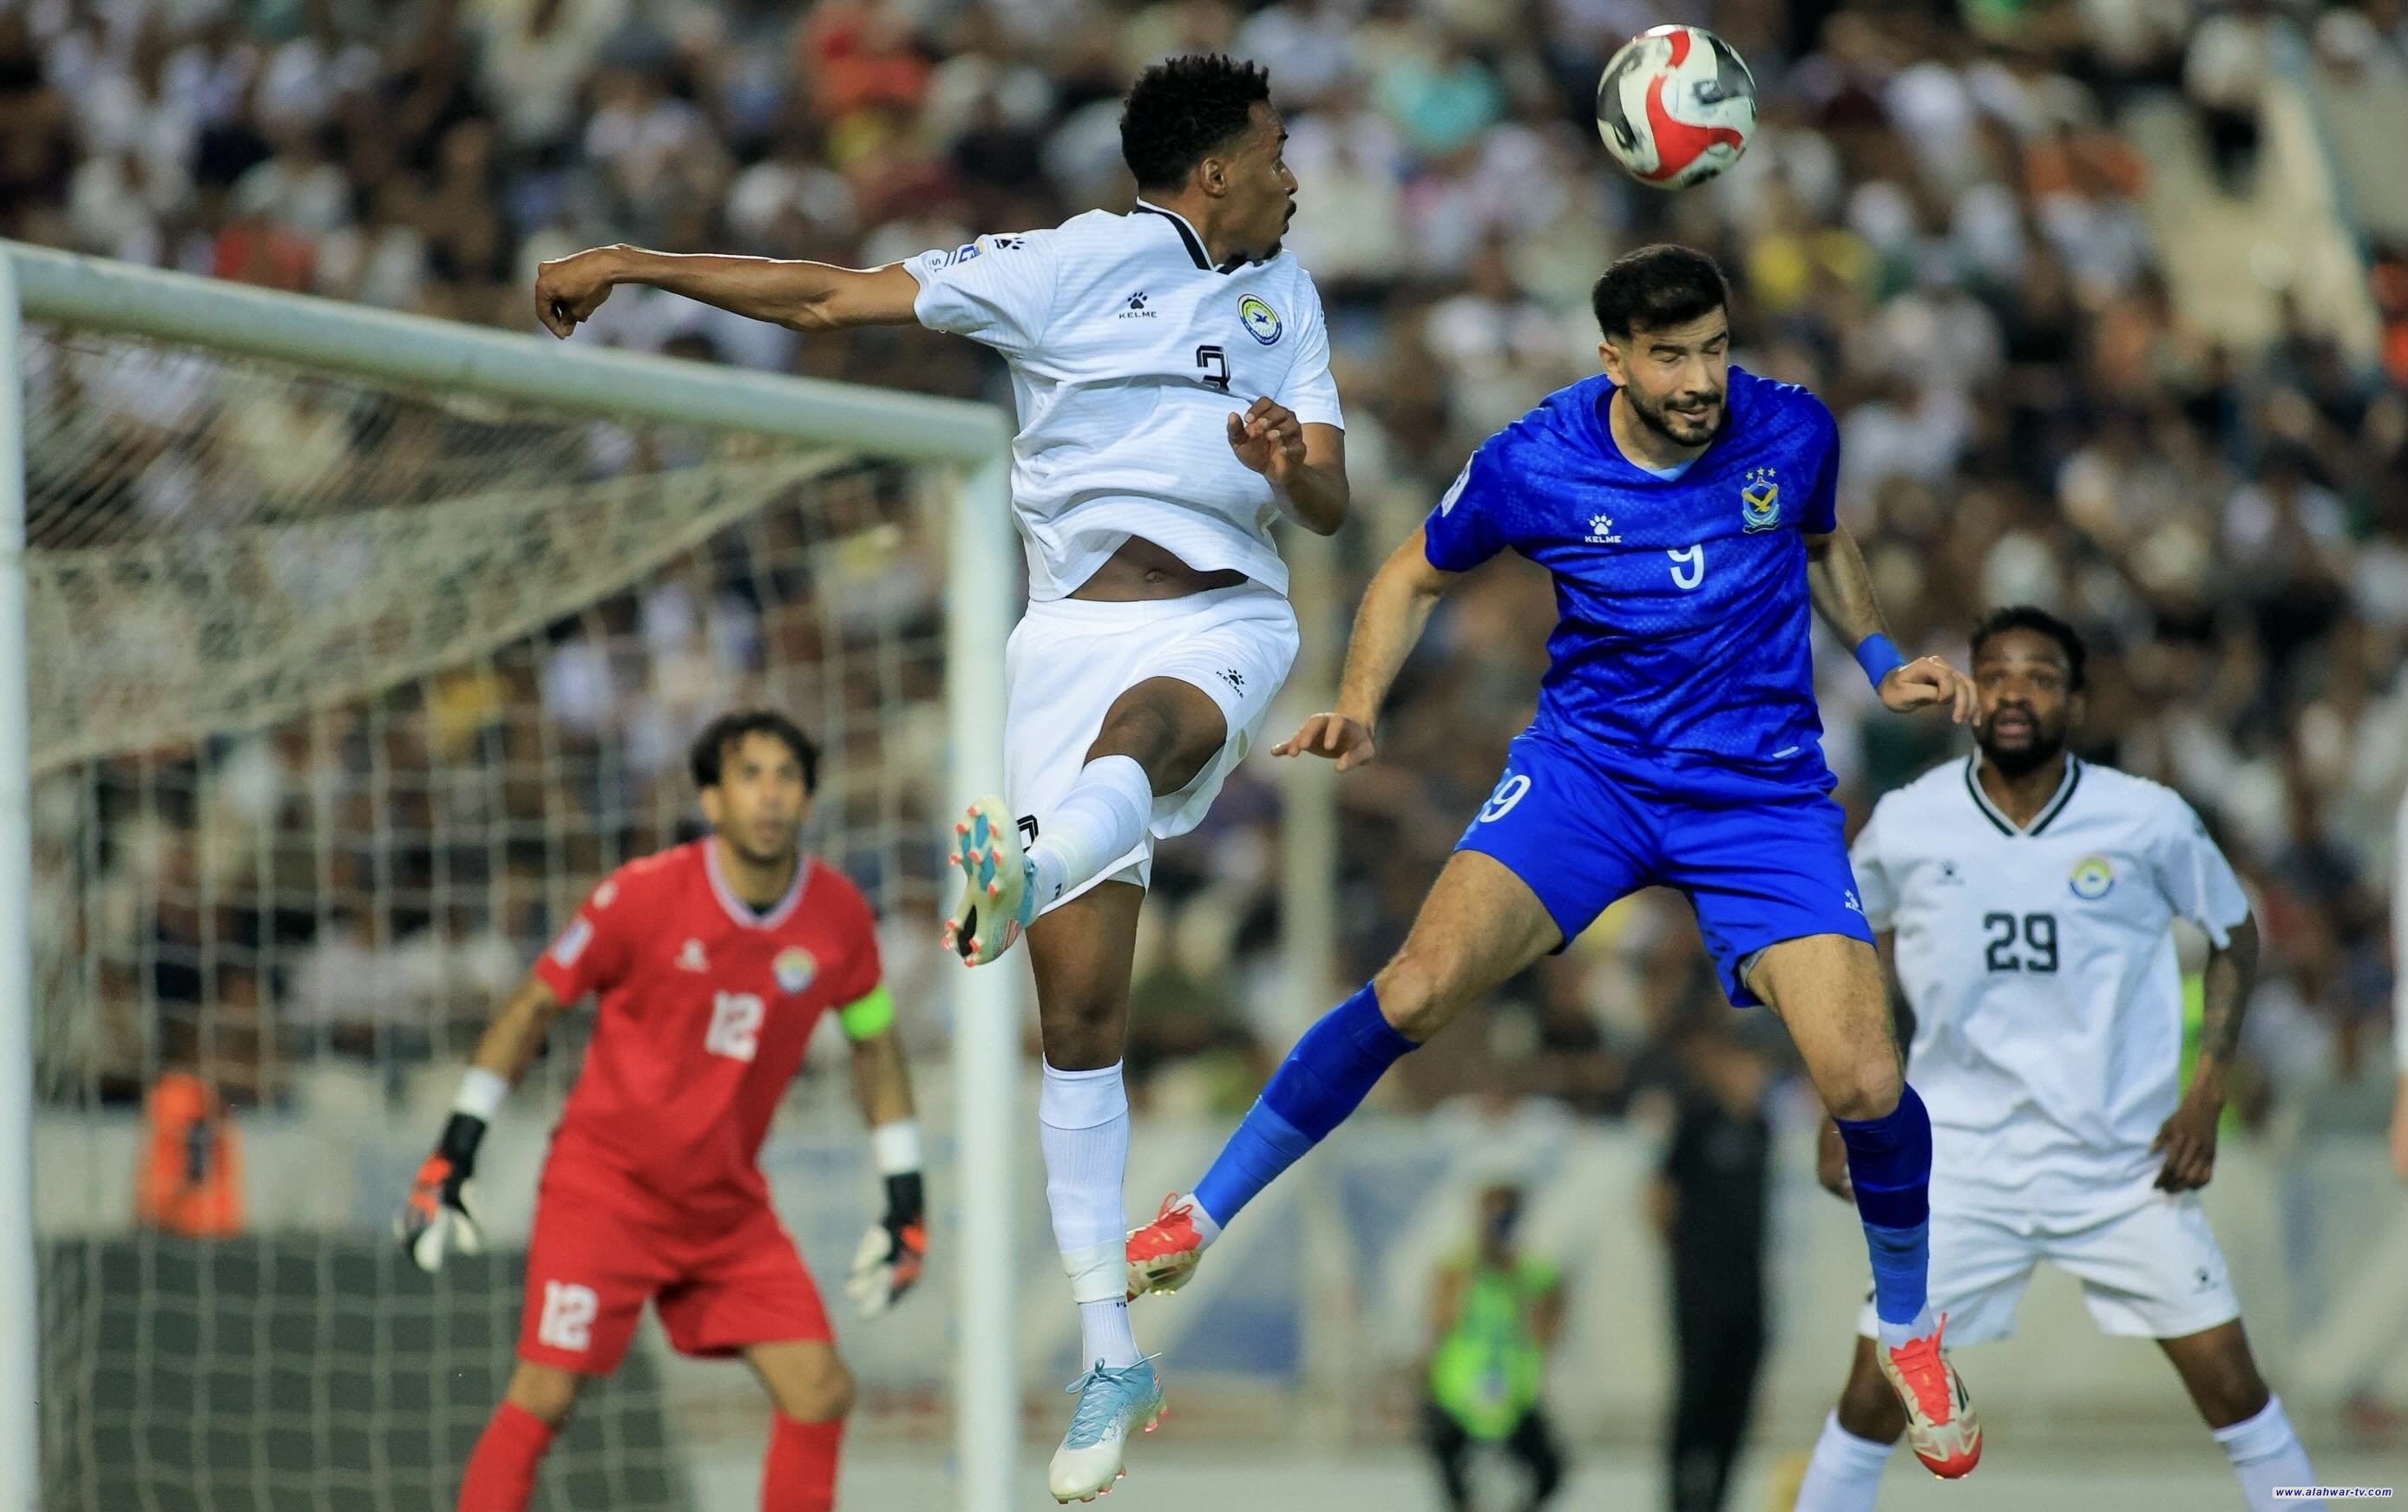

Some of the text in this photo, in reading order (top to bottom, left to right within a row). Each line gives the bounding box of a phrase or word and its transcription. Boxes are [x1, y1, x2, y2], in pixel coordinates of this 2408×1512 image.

[1667, 543, 1704, 590] 9
[1480, 775, 1531, 822] 9
[1983, 913, 2058, 972] 29
[705, 991, 765, 1062] 12
[539, 1280, 599, 1351] 12
